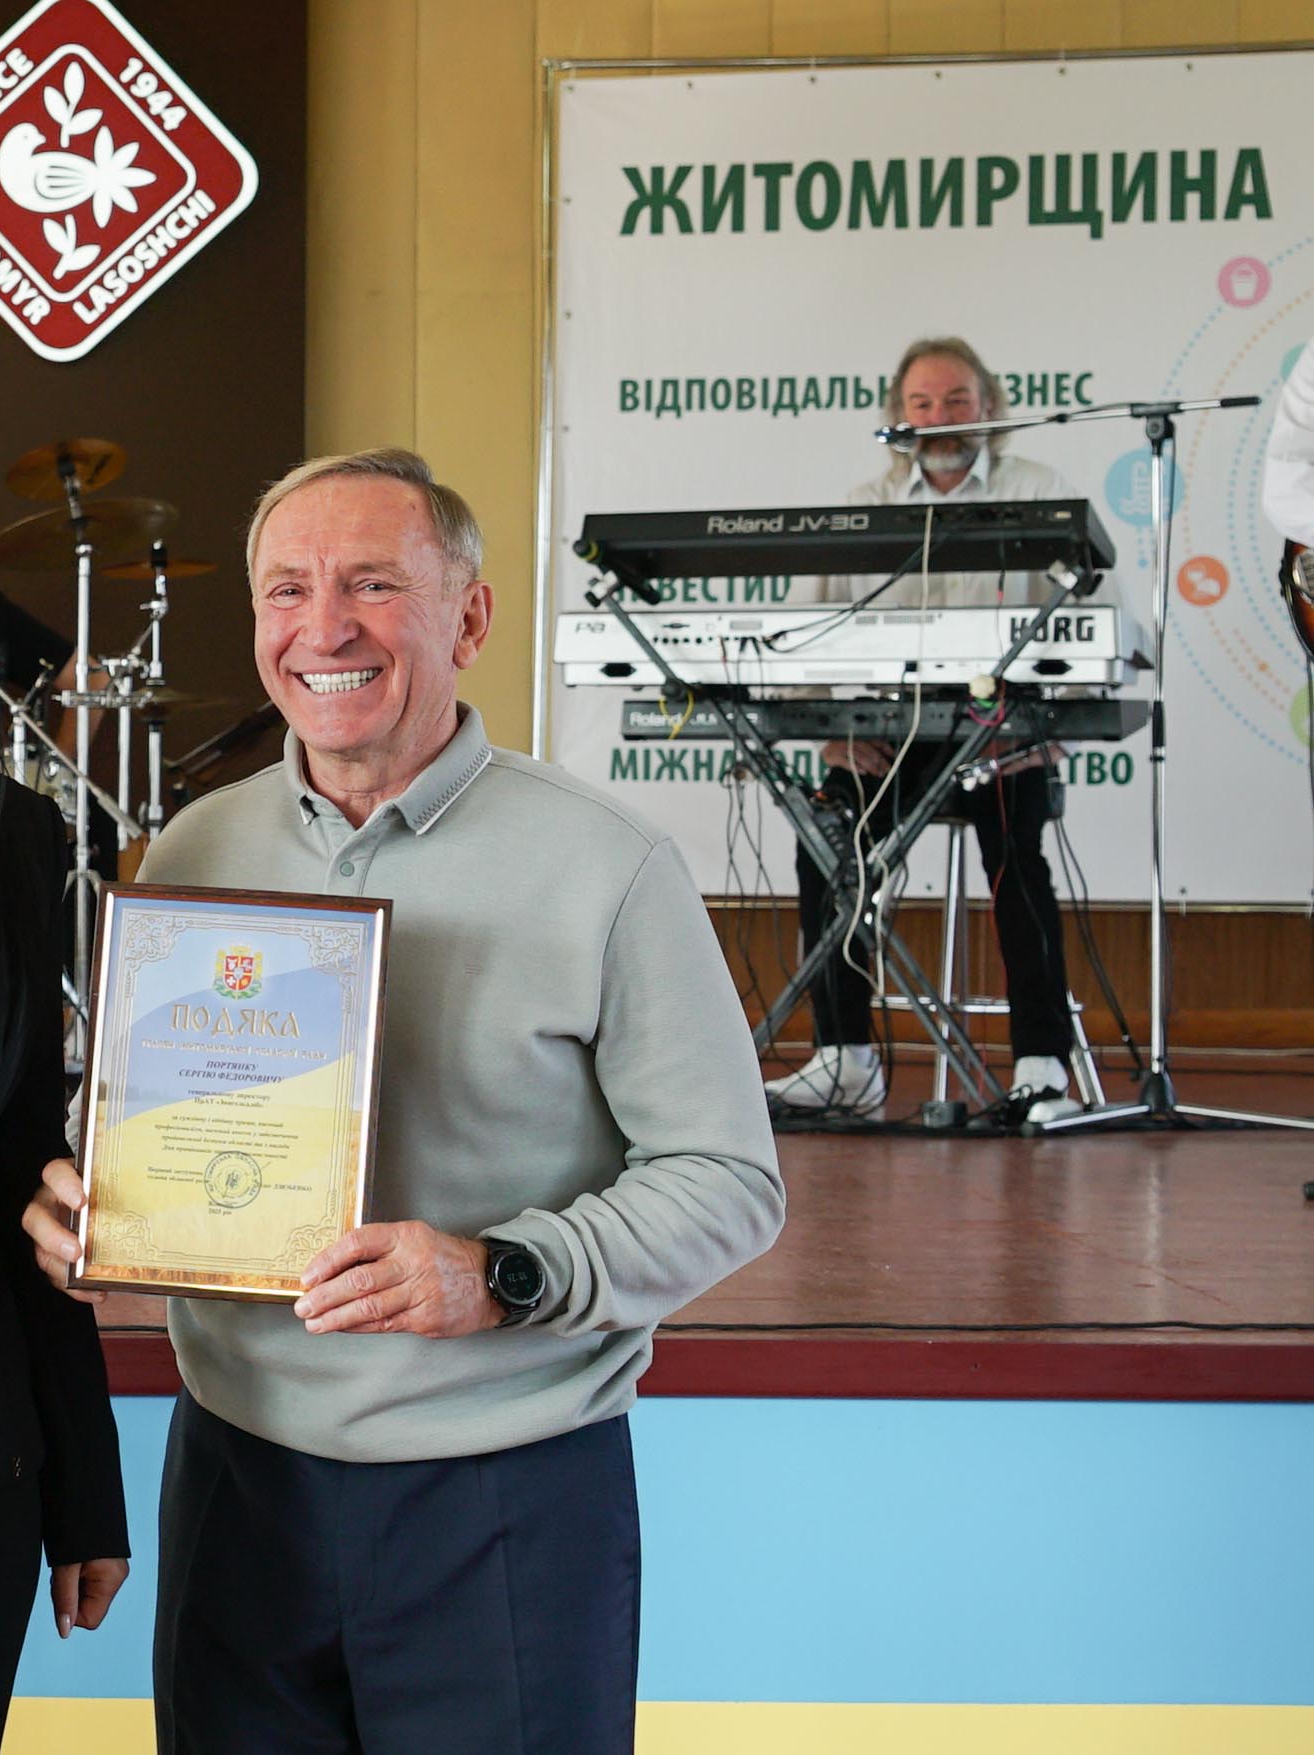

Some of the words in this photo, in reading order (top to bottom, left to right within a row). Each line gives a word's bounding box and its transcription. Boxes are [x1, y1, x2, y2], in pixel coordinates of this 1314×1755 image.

[119, 57, 188, 132] 1944
[618, 147, 1274, 241] ЖИТОМИРЩИНА
[72, 189, 217, 325] LASOSHCHI
[706, 513, 785, 535] Roland
[170, 1003, 301, 1040] ПОДЯКА
